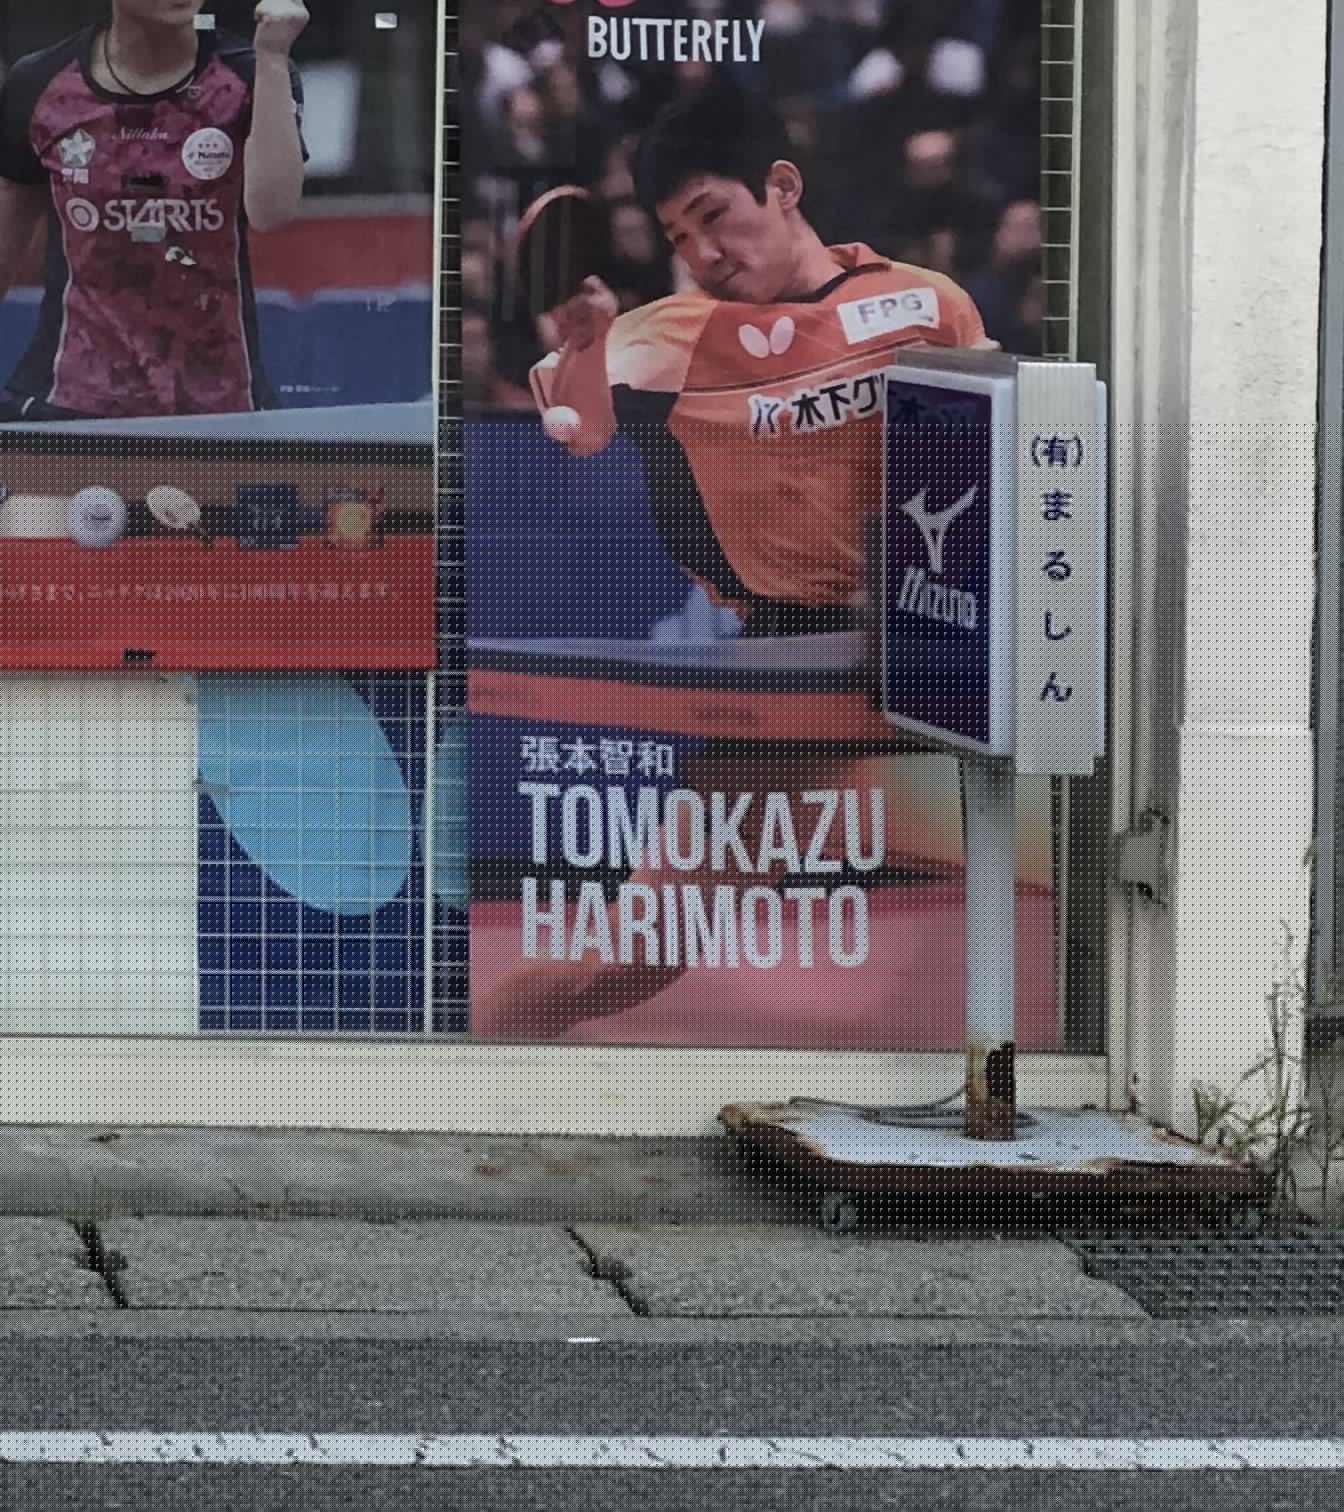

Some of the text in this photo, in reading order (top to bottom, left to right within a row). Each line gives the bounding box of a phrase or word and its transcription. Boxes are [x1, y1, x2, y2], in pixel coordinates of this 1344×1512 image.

[588, 16, 765, 62] BUTTERFLY
[857, 294, 922, 324] FPG
[522, 736, 675, 776] 張本智和
[518, 782, 887, 874] TOMOKAZU
[520, 877, 871, 968] HARIMOTO
